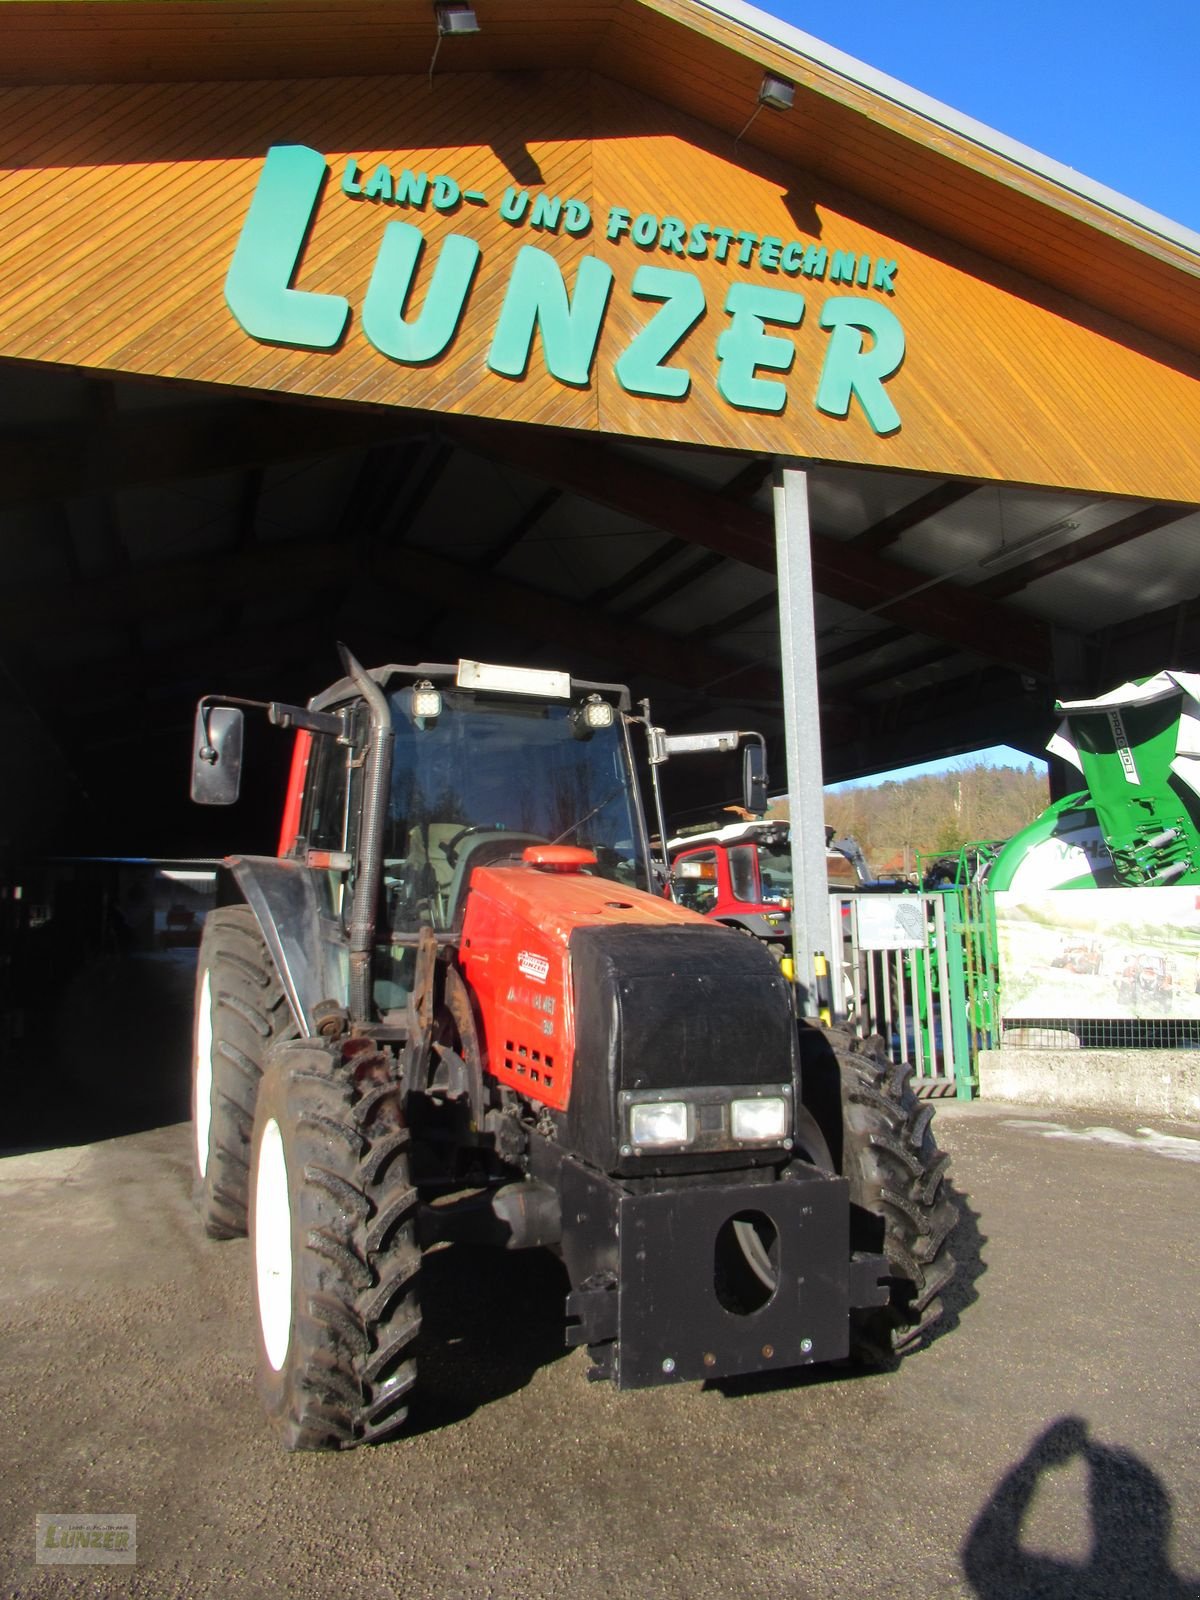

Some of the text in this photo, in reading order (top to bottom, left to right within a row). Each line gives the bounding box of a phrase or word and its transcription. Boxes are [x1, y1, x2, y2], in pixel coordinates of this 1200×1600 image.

[224, 144, 906, 435] LUNZER
[341, 158, 898, 294] LAND- UND FORSTTECHNIK
